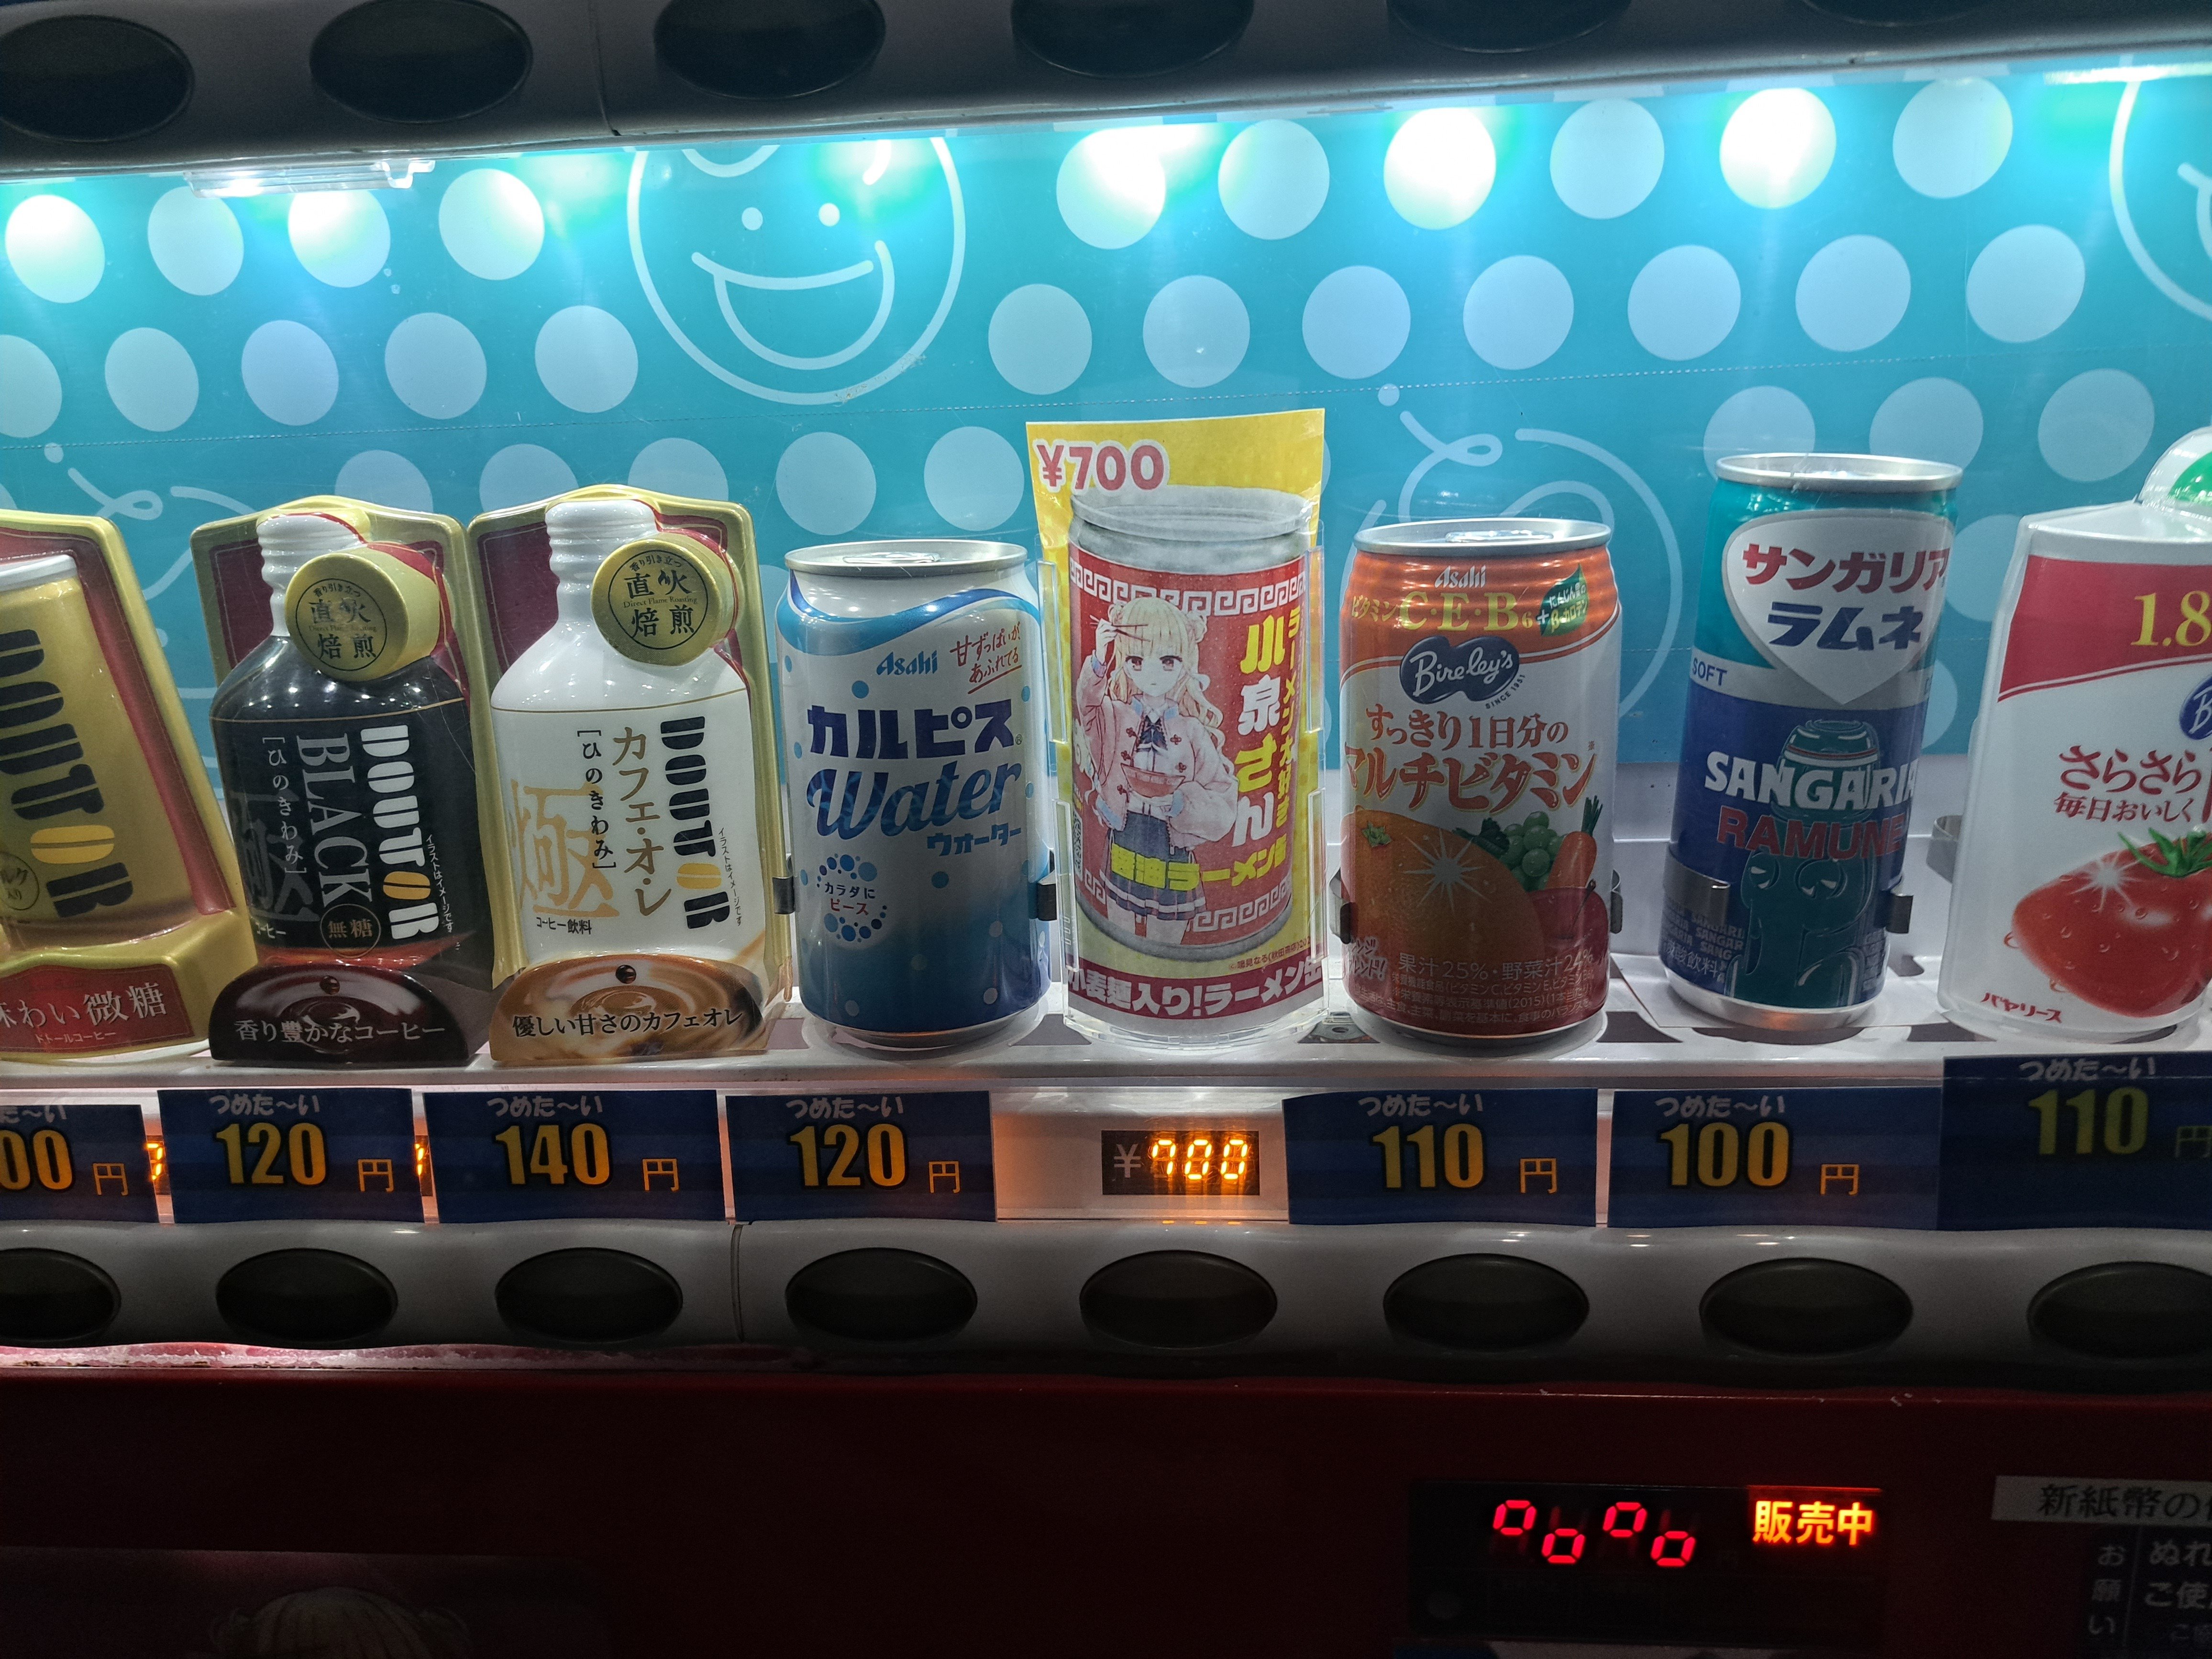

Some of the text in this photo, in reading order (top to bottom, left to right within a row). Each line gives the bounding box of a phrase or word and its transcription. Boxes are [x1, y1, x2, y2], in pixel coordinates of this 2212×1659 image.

[1036, 444, 1164, 491] ¥700
[624, 569, 692, 599] 直火
[630, 555, 682, 572] 香り引き立つ
[1435, 564, 1486, 589] Asahi
[1743, 543, 1950, 594] サンガリア
[623, 600, 648, 608] Direct
[669, 596, 698, 605] Roasting
[631, 604, 695, 638] 焙煎
[318, 633, 379, 659] 焙煎
[1767, 602, 1924, 651] ラムネ
[876, 650, 939, 675] Asahi
[969, 646, 1019, 683] あふれてる
[1409, 646, 1514, 697] Bireley's
[1692, 657, 1727, 686] SOFT
[1485, 691, 1511, 709] SINCE
[807, 698, 1014, 760] カルピス
[1233, 615, 1285, 848] 小泉さん
[1365, 703, 1569, 751] すっきり1日分の
[1344, 741, 1597, 813] マルチビタミン
[1704, 750, 1919, 811] SANGARIA
[2058, 745, 2201, 795] さらさら
[296, 732, 373, 907] BLACK
[660, 716, 730, 929] DOUTOR
[806, 760, 1022, 841] Water
[2054, 792, 2195, 823] 毎日おいしく
[360, 724, 440, 940] DOUTOR
[1716, 805, 1906, 861] RAMUNE
[425, 834, 453, 933] イラストはイメージです
[718, 827, 742, 927] イラストはイメージです
[825, 882, 875, 899] カラダに
[328, 918, 373, 939] 無糖
[536, 916, 592, 935] コーヒー飲料
[234, 1019, 445, 1043] 香り豊かなコーヒー
[512, 1007, 743, 1038] 優しい甘さのカフェオレ
[1980, 992, 2062, 1024] バヤリース
[34, 1031, 116, 1044] ドトールコーヒー
[2028, 1087, 2149, 1155] 110
[92, 1162, 129, 1196] 円
[216, 1122, 327, 1185] 120
[357, 1159, 394, 1193] 円
[495, 1123, 679, 1192] 140 円
[790, 1123, 961, 1194] 120 円
[1372, 1123, 1558, 1194] 110 円
[1660, 1121, 1860, 1195] 100 円
[1753, 1500, 1873, 1546] 販売中
[2038, 1483, 2212, 1519] 新紙幣の
[2144, 1581, 2212, 1610] ご使
